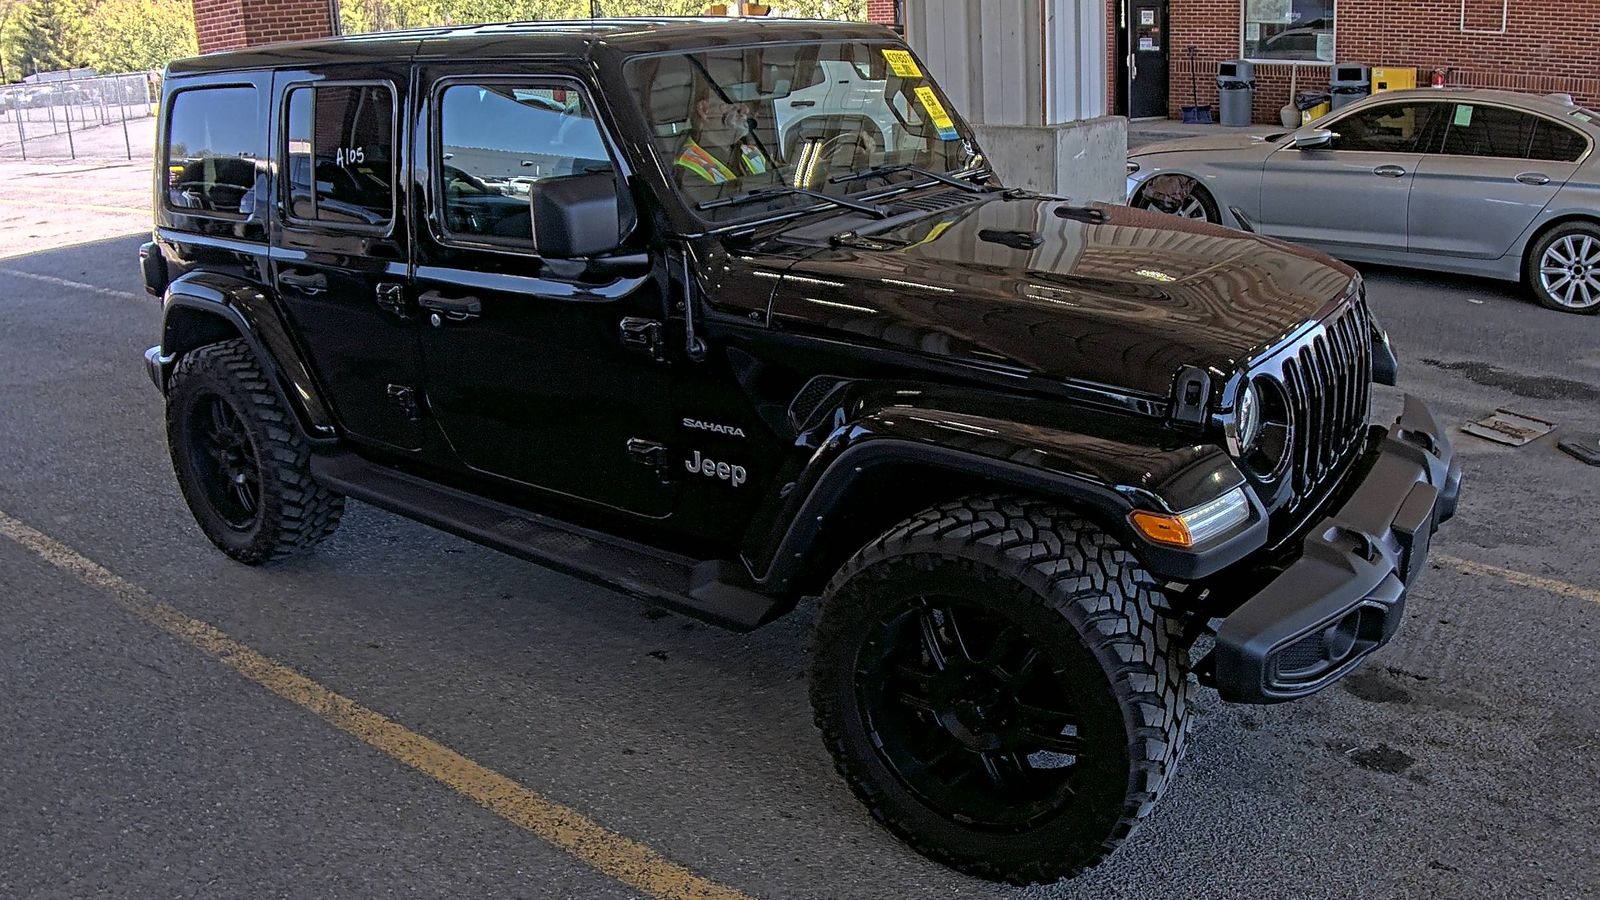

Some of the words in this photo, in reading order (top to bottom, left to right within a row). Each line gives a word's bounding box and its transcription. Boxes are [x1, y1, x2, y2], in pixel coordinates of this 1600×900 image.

[336, 146, 364, 168] A105
[683, 418, 746, 437] SAHARA
[685, 450, 747, 487] Jeep
